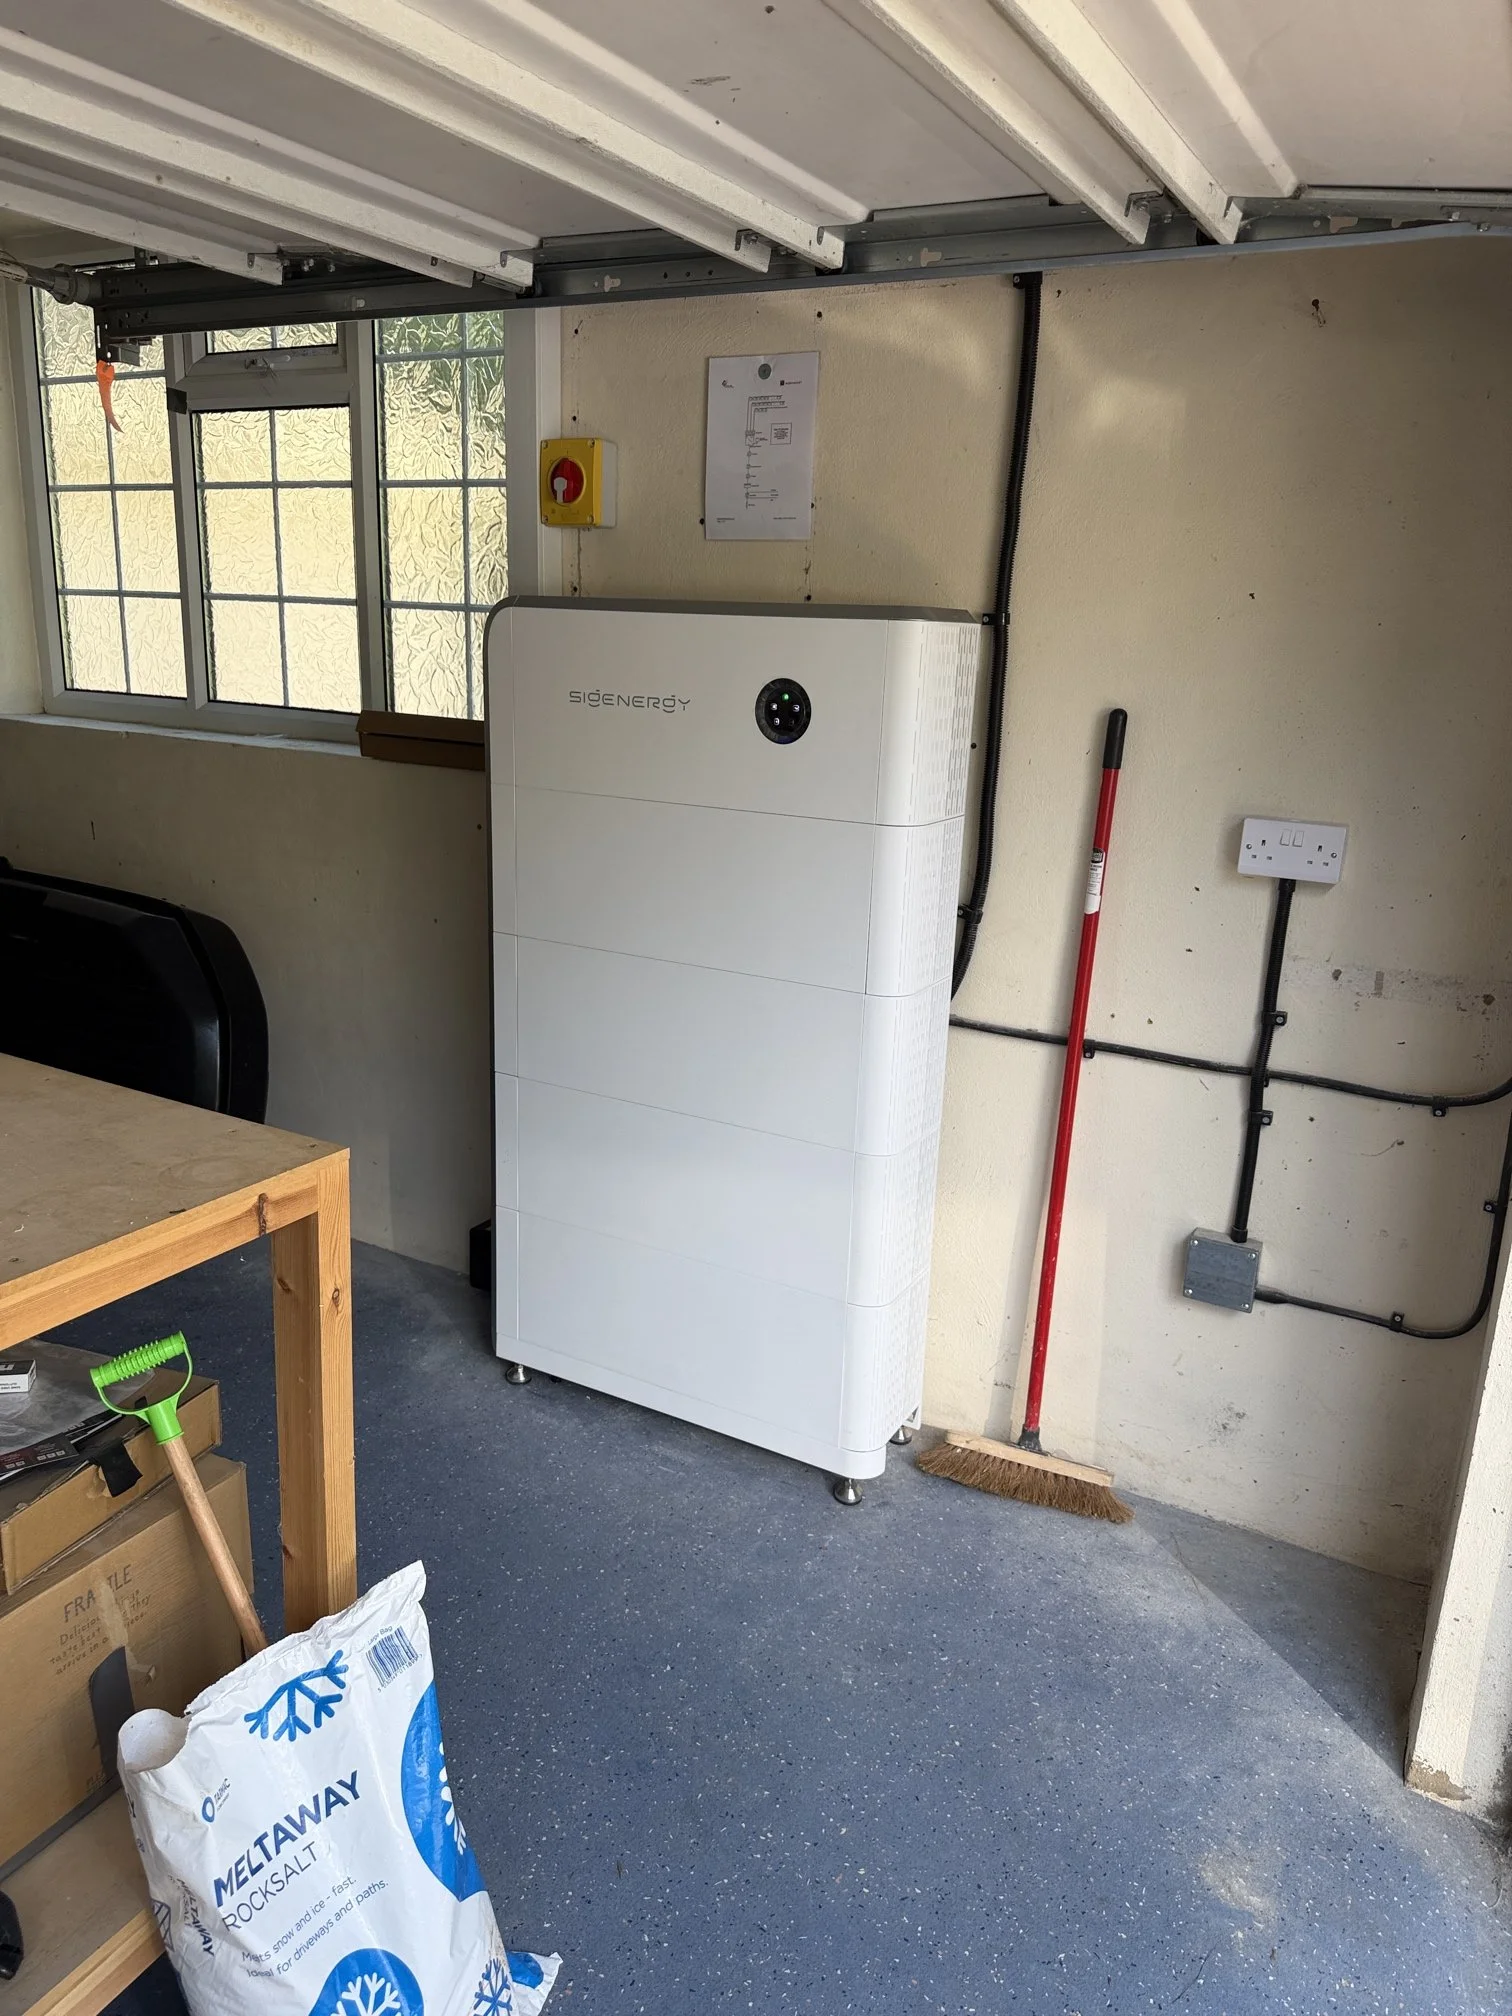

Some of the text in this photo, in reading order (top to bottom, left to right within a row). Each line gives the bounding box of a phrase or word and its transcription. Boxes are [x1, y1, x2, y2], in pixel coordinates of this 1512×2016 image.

[63, 1564, 132, 1623] FRAILE
[380, 1625, 393, 1635] Bag
[213, 1769, 361, 1908] MELTAWAY
[222, 1840, 318, 1932] ROCKSALT
[272, 1928, 294, 1954] snow
[295, 1910, 312, 1932] and
[310, 1899, 326, 1916] ice
[331, 1875, 357, 1897] fast.
[276, 1957, 293, 1975] for
[293, 1918, 334, 1961] driveways
[334, 1898, 354, 1922] and
[355, 1879, 389, 1906] paths.
